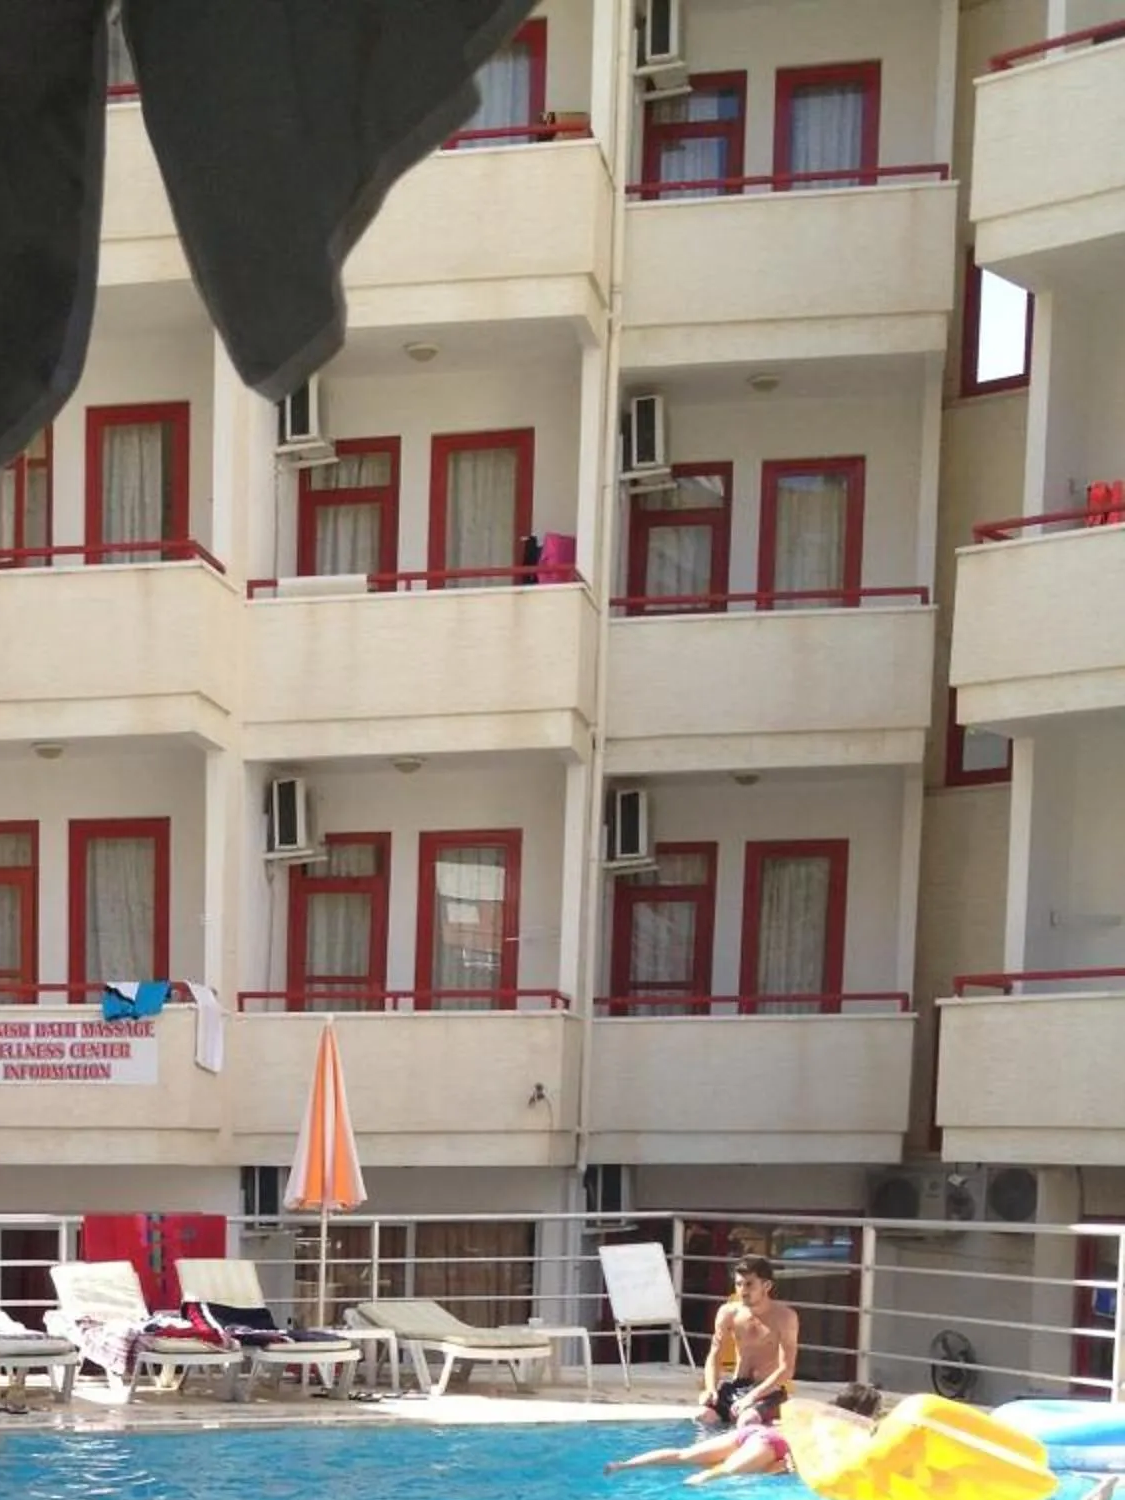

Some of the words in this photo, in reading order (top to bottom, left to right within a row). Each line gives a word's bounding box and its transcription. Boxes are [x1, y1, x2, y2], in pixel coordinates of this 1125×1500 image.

[35, 1022, 76, 1038] BATH
[81, 1021, 155, 1038] MASSAGE
[69, 1042, 131, 1058] CENTER
[2, 1064, 112, 1079] INFORMATION
